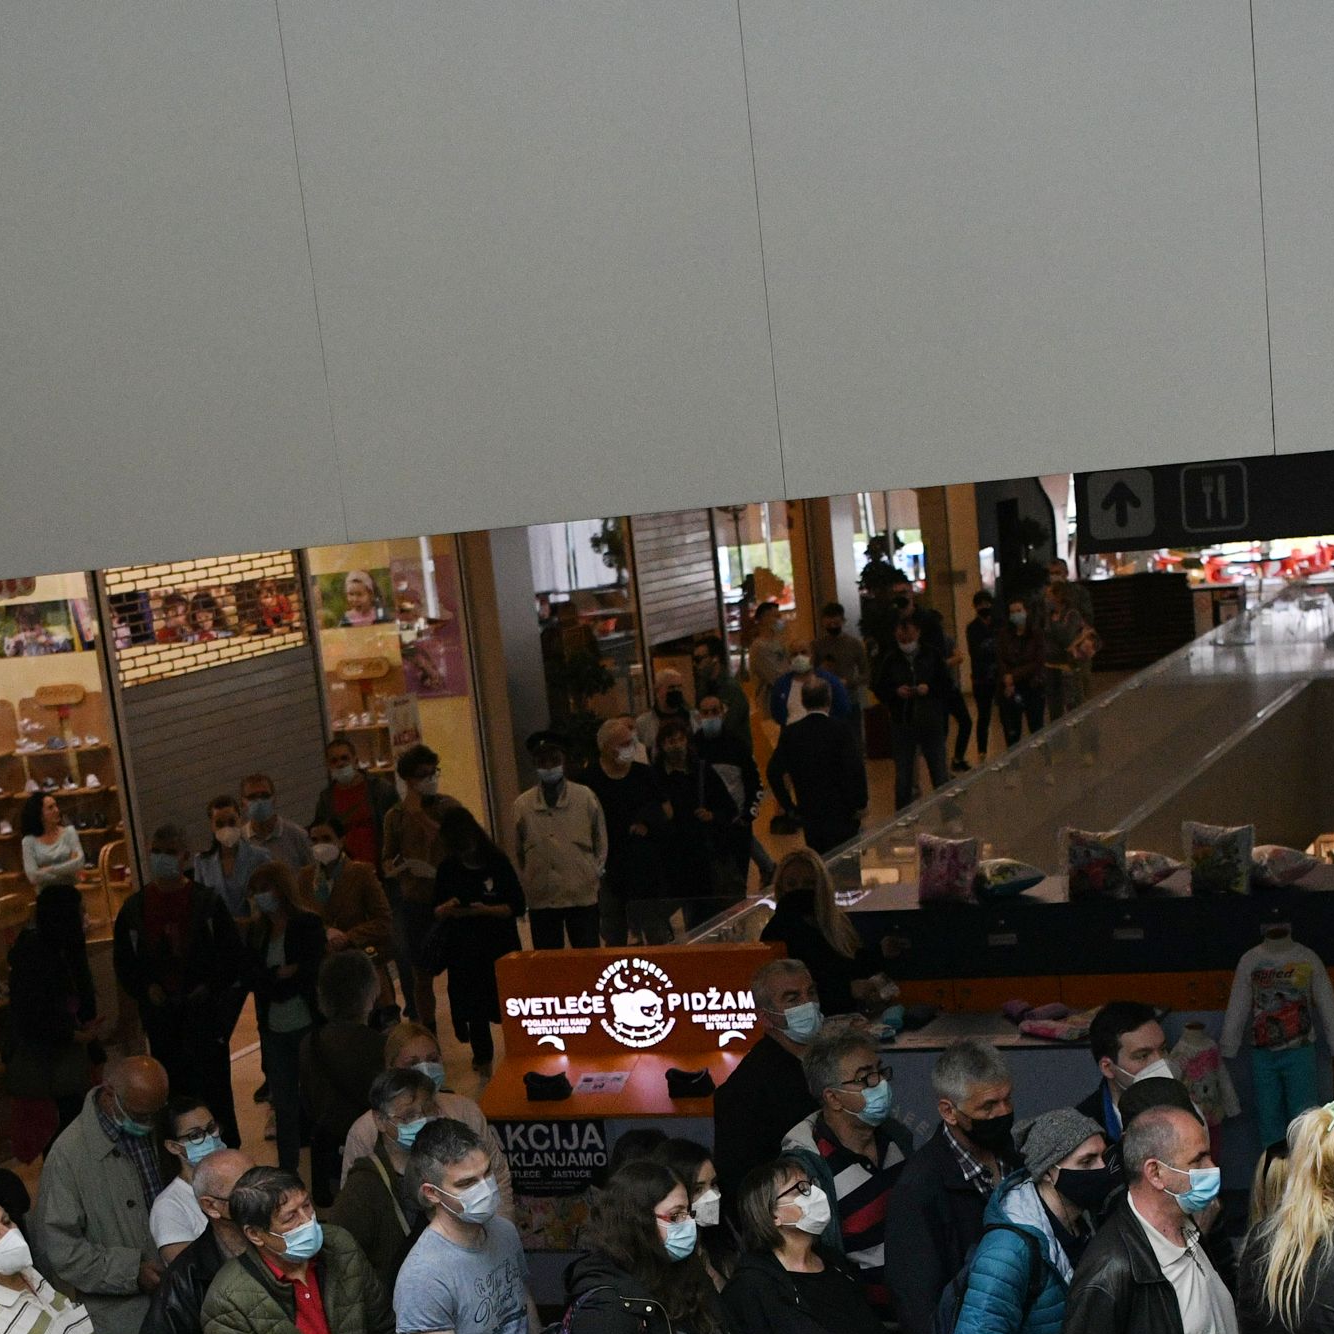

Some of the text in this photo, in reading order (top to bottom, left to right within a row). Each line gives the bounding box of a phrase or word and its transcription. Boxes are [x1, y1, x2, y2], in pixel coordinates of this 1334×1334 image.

[505, 986, 757, 1018] SVETLEĆE PIDŽAM
[508, 1151, 608, 1168] KLANJAMO
